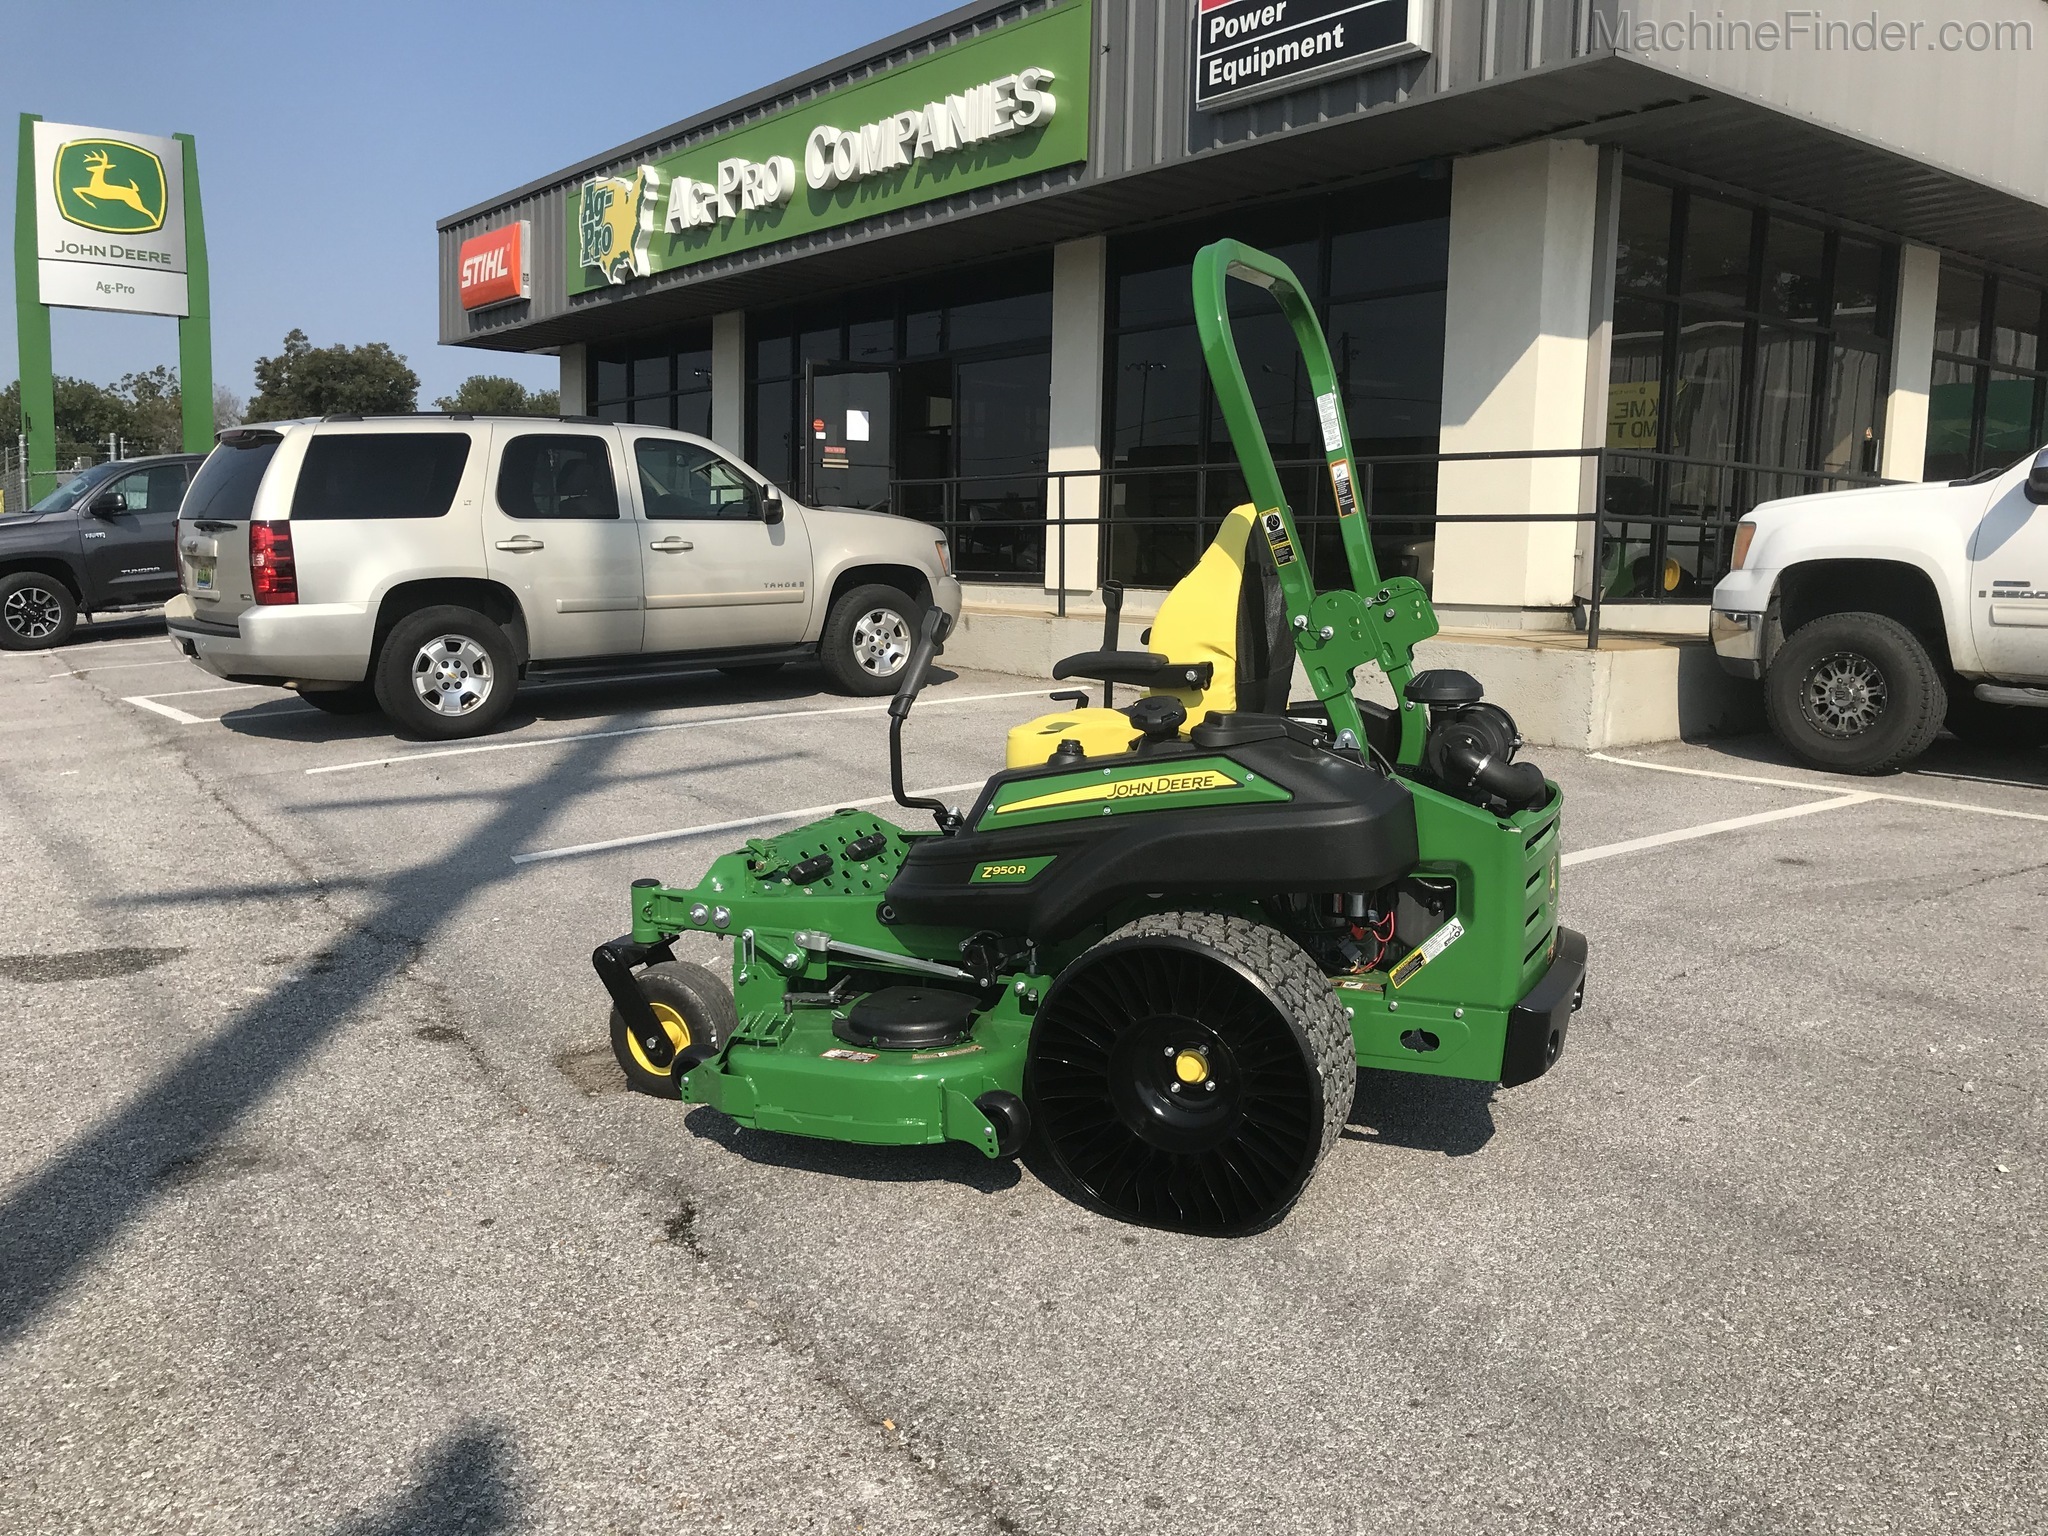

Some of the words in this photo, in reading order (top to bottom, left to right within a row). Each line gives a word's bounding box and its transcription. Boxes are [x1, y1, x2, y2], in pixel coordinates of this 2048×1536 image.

[1209, 0, 1287, 44] Power
[1208, 23, 1345, 86] Equipment
[804, 66, 1057, 190] COMPANIES
[582, 182, 614, 228] Ag-
[55, 240, 107, 257] JOHN
[110, 244, 171, 264] DEERE
[582, 222, 614, 264] Pro
[96, 281, 135, 294] Ag-Pro
[461, 246, 508, 289] STIHL
[1106, 781, 1153, 799] JOHN
[1156, 776, 1215, 793] DEERE
[981, 865, 1026, 879] Z950R
